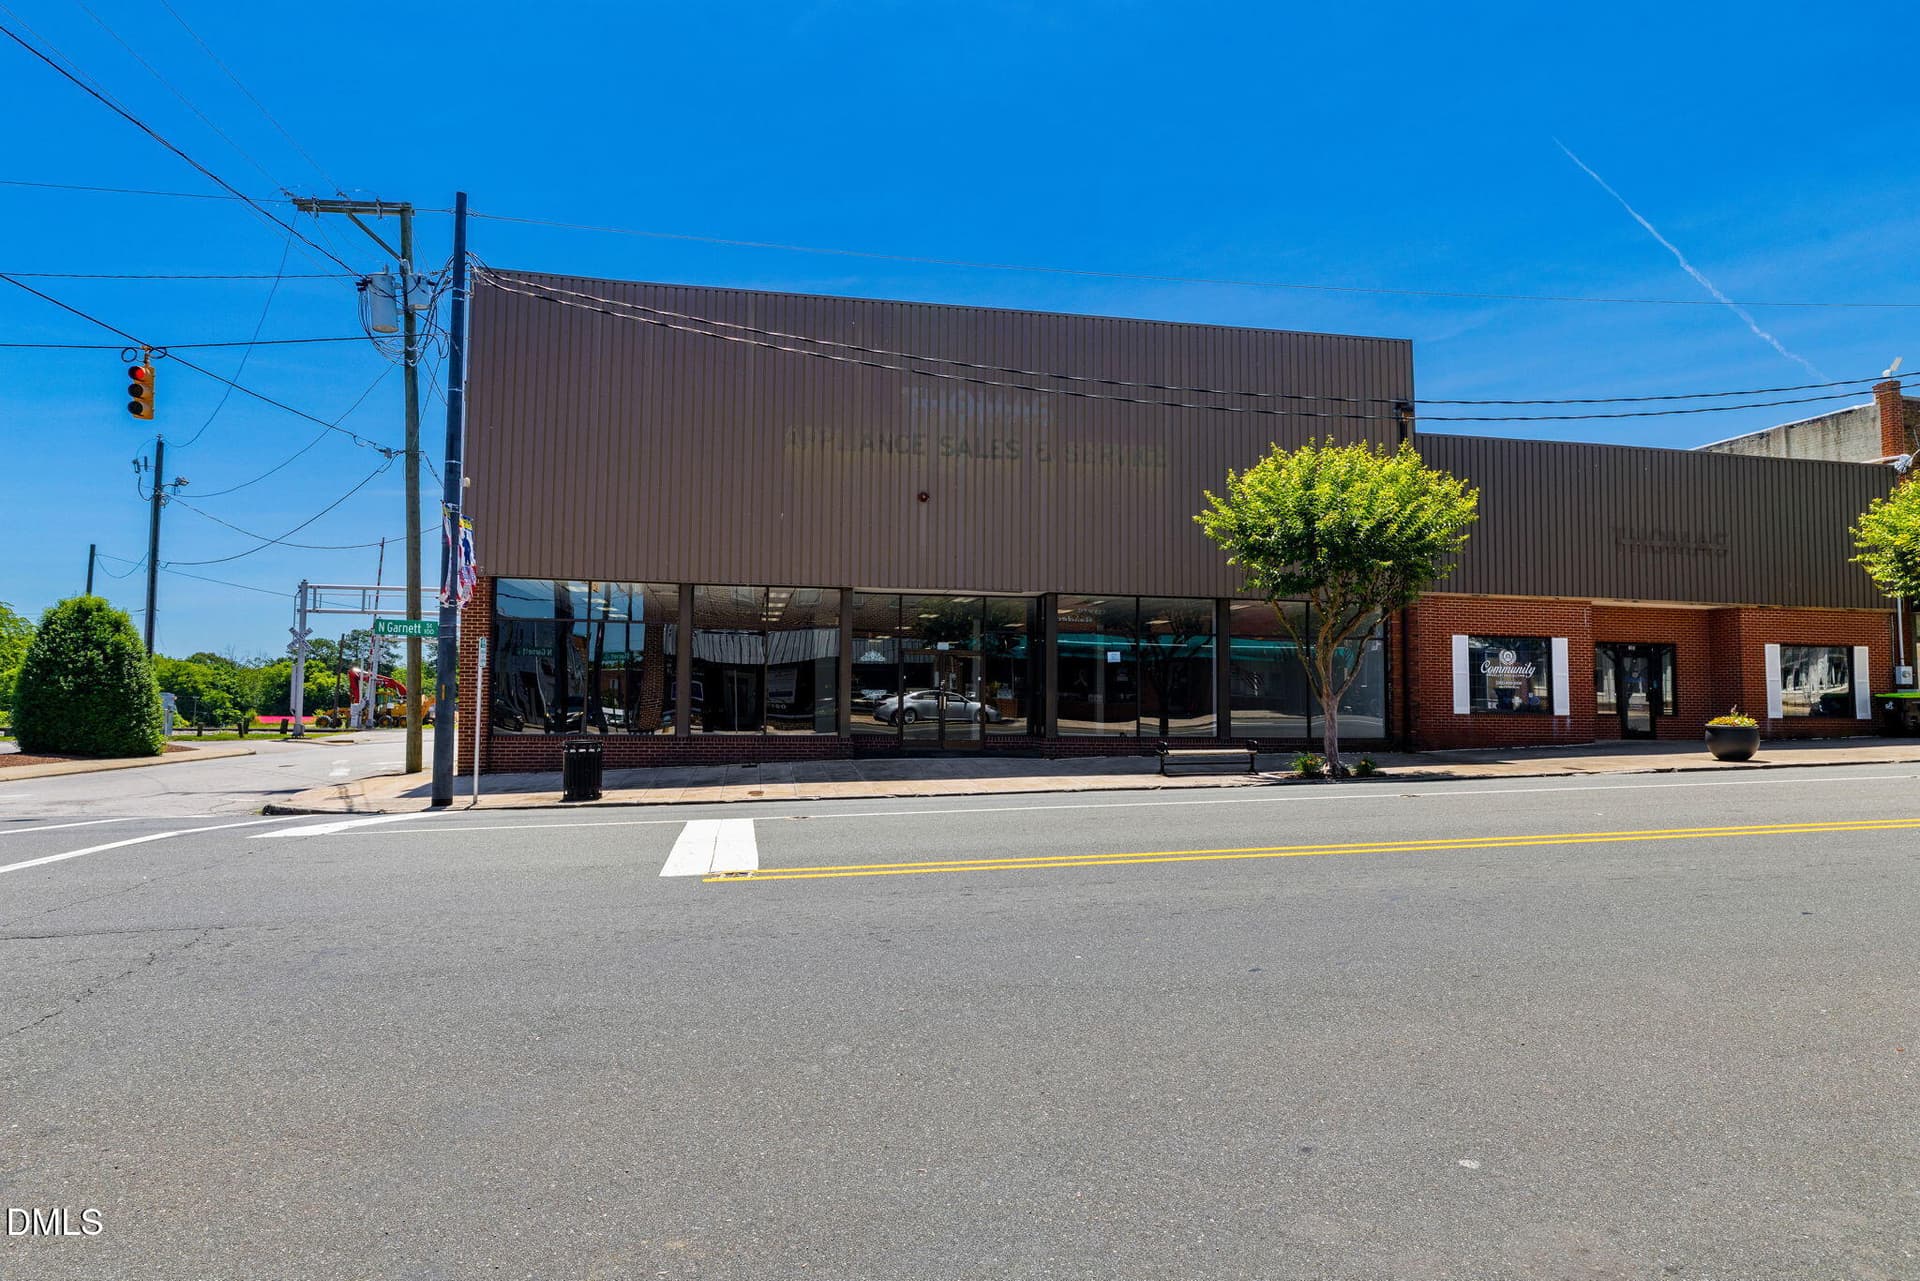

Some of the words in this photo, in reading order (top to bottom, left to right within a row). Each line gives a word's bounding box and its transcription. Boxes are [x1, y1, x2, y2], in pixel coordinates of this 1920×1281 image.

[785, 425, 927, 456] APPLANCE
[938, 434, 1024, 462] SALES
[378, 622, 385, 633] N
[387, 622, 421, 634] Garnett
[1480, 659, 1536, 679] Community
